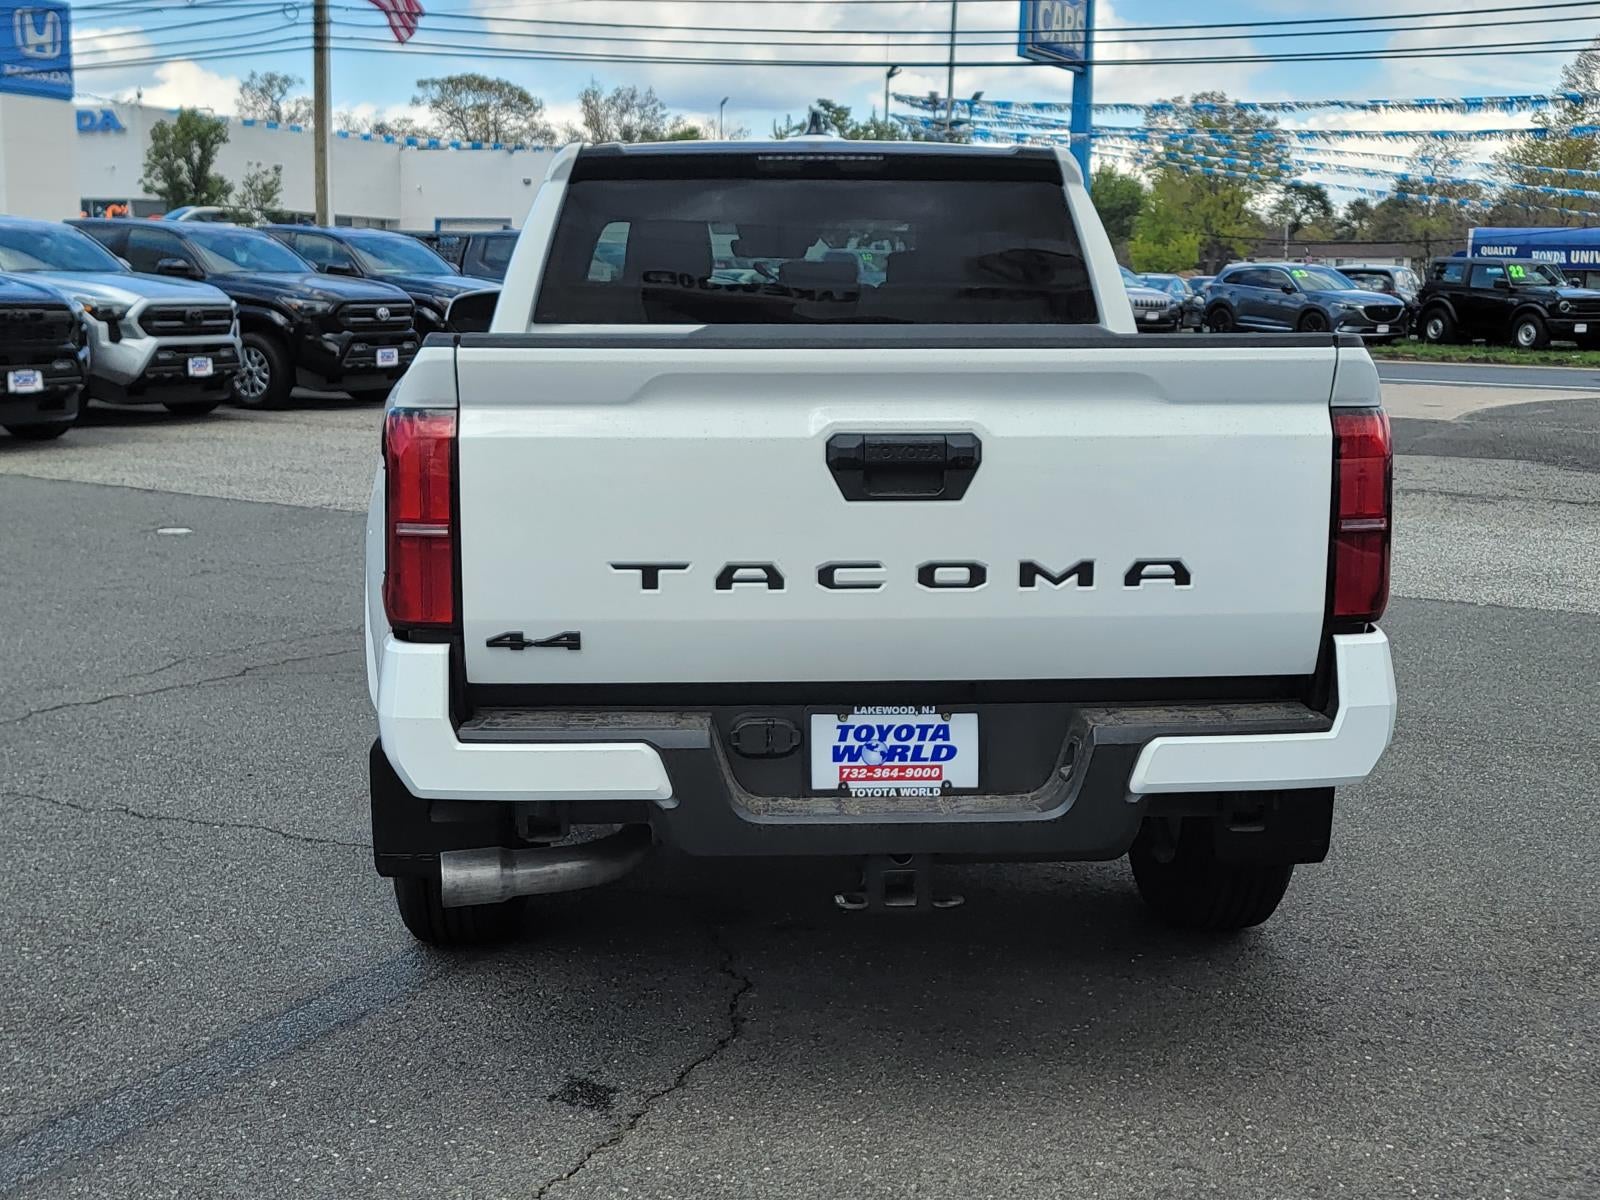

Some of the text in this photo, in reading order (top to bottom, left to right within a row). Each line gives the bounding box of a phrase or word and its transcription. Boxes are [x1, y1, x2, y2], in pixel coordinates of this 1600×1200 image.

[1481, 246, 1517, 256] QUALITY
[1532, 251, 1567, 264] HONDA
[1508, 264, 1526, 278] 22
[608, 557, 1193, 592] TACOMA
[853, 705, 937, 716] LAKEWOOD, NJ
[836, 723, 951, 743] TOYOTA
[841, 767, 941, 779] 732-364-9000
[850, 786, 942, 797] TOYOTA WORLD
